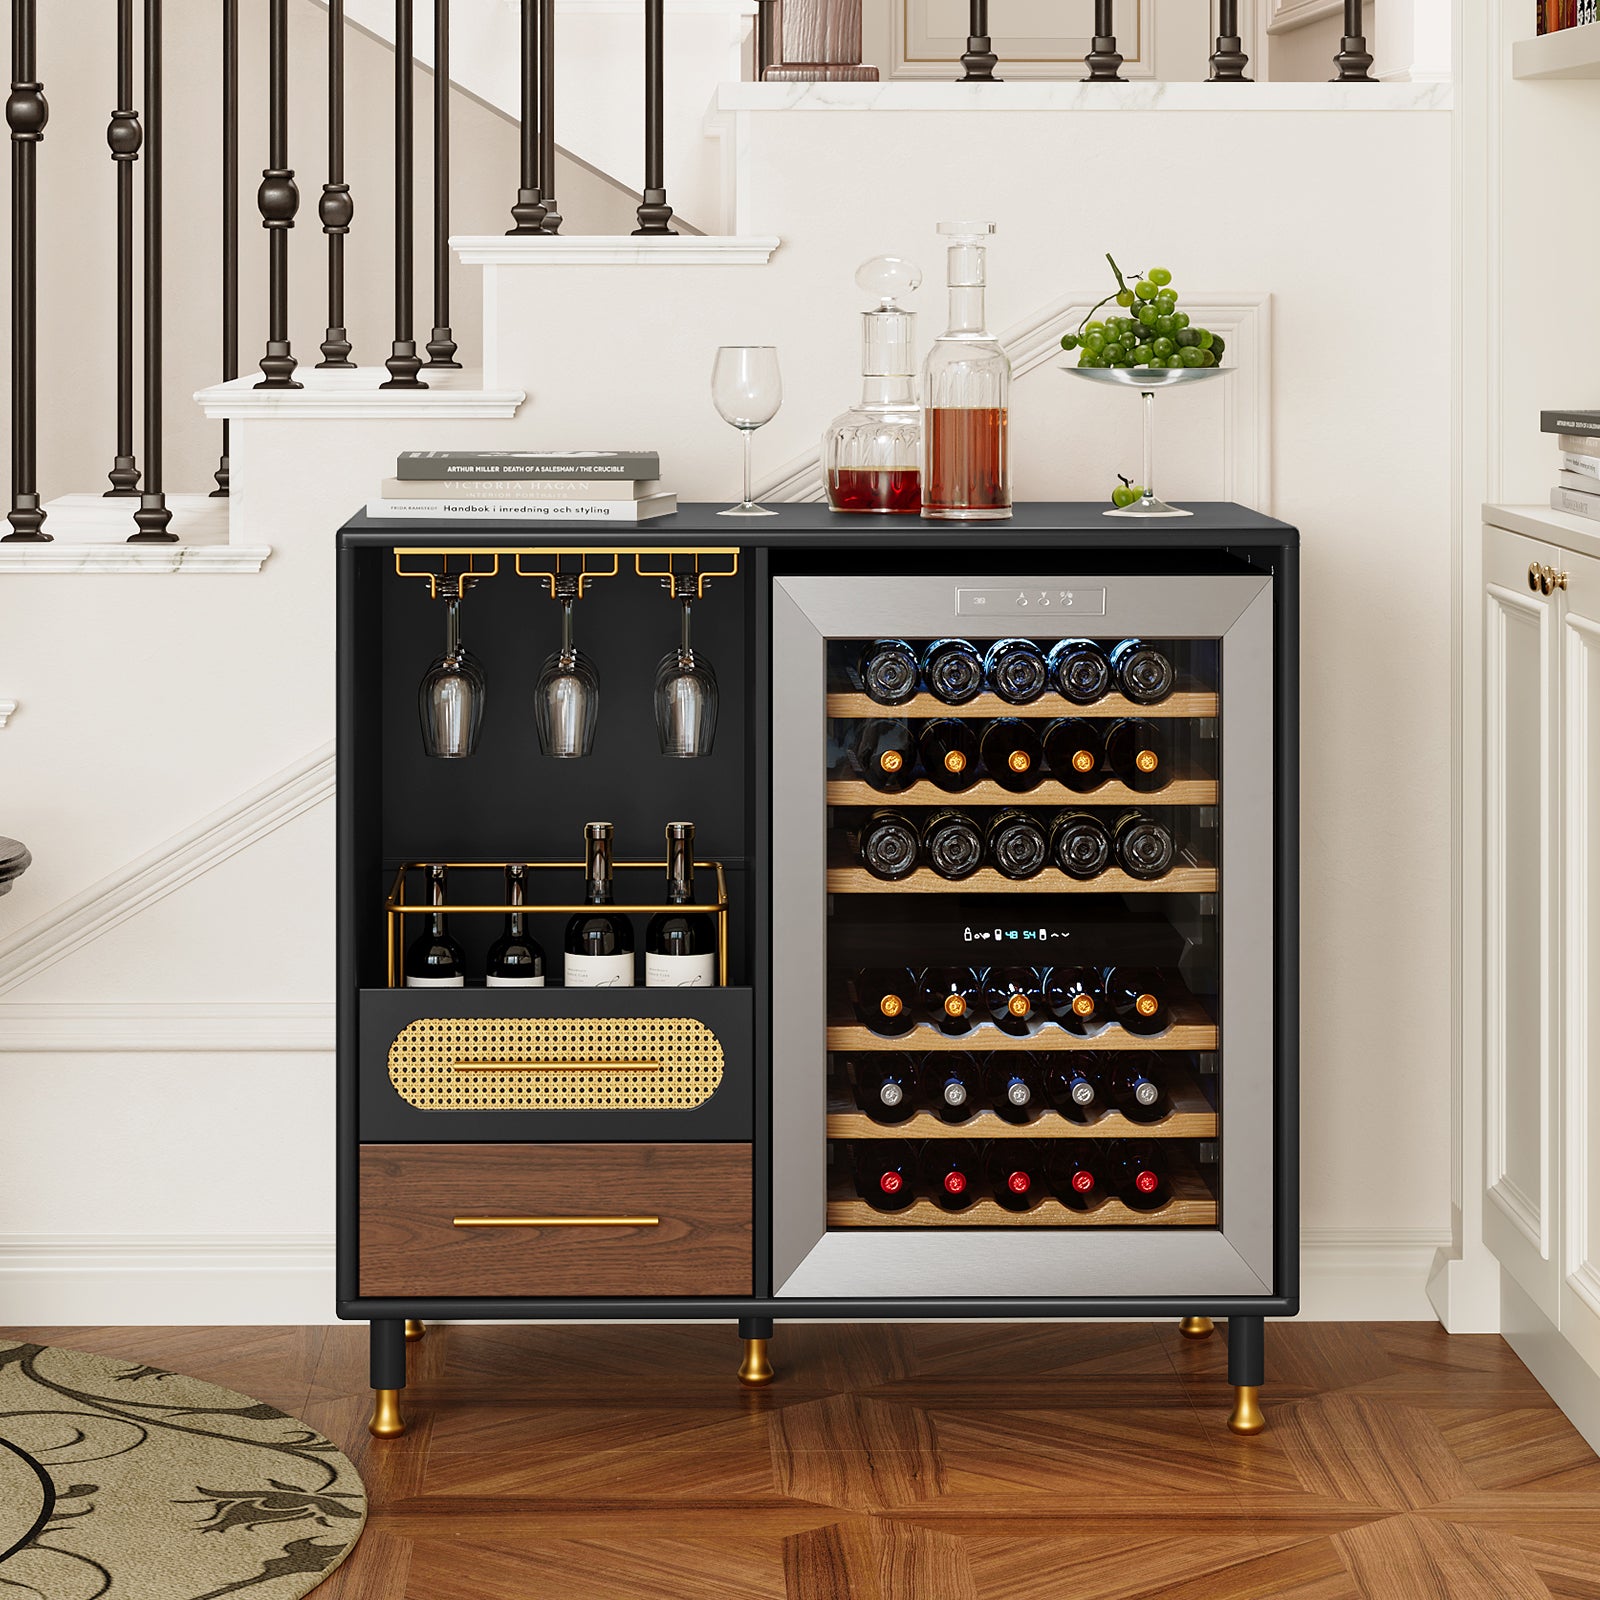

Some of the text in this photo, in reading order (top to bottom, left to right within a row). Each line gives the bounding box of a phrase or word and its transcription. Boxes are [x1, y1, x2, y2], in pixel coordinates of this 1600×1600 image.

[447, 465, 474, 473] ARTHUR
[475, 465, 500, 473] MILLER
[502, 465, 525, 473] DEATH
[525, 465, 535, 473] OF
[535, 465, 540, 473] A
[540, 465, 575, 473] SALESMAN
[579, 465, 592, 473] THE
[593, 465, 625, 473] CRUCIBLE
[443, 481, 590, 490] VICTORIA HAGAN
[443, 505, 490, 513] Handbok
[499, 505, 549, 515] inredning
[575, 506, 610, 515] styling
[1004, 930, 1036, 940] 48 54
